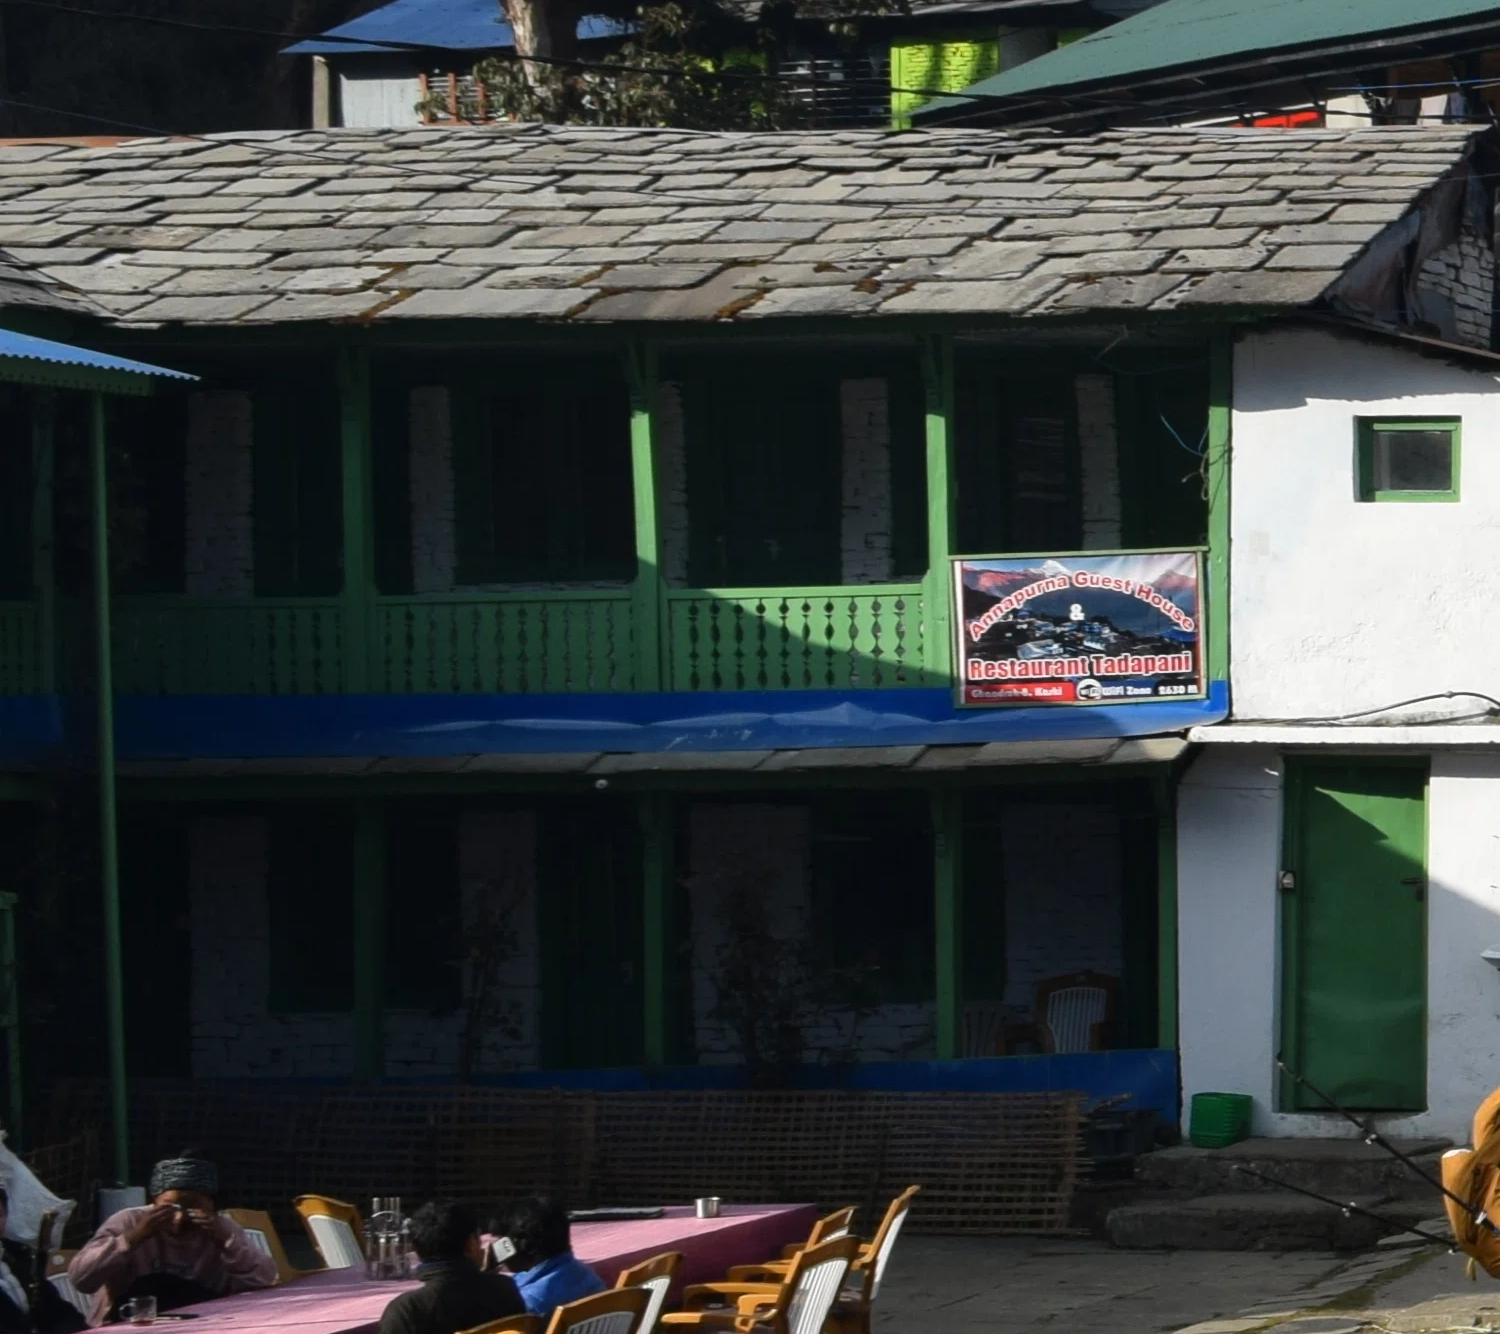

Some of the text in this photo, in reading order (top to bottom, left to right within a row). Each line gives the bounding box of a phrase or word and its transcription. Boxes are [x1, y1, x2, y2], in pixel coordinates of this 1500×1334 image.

[969, 570, 1196, 642] Annapurna Guest House
[968, 651, 1193, 681] Restaurant Tadapani
